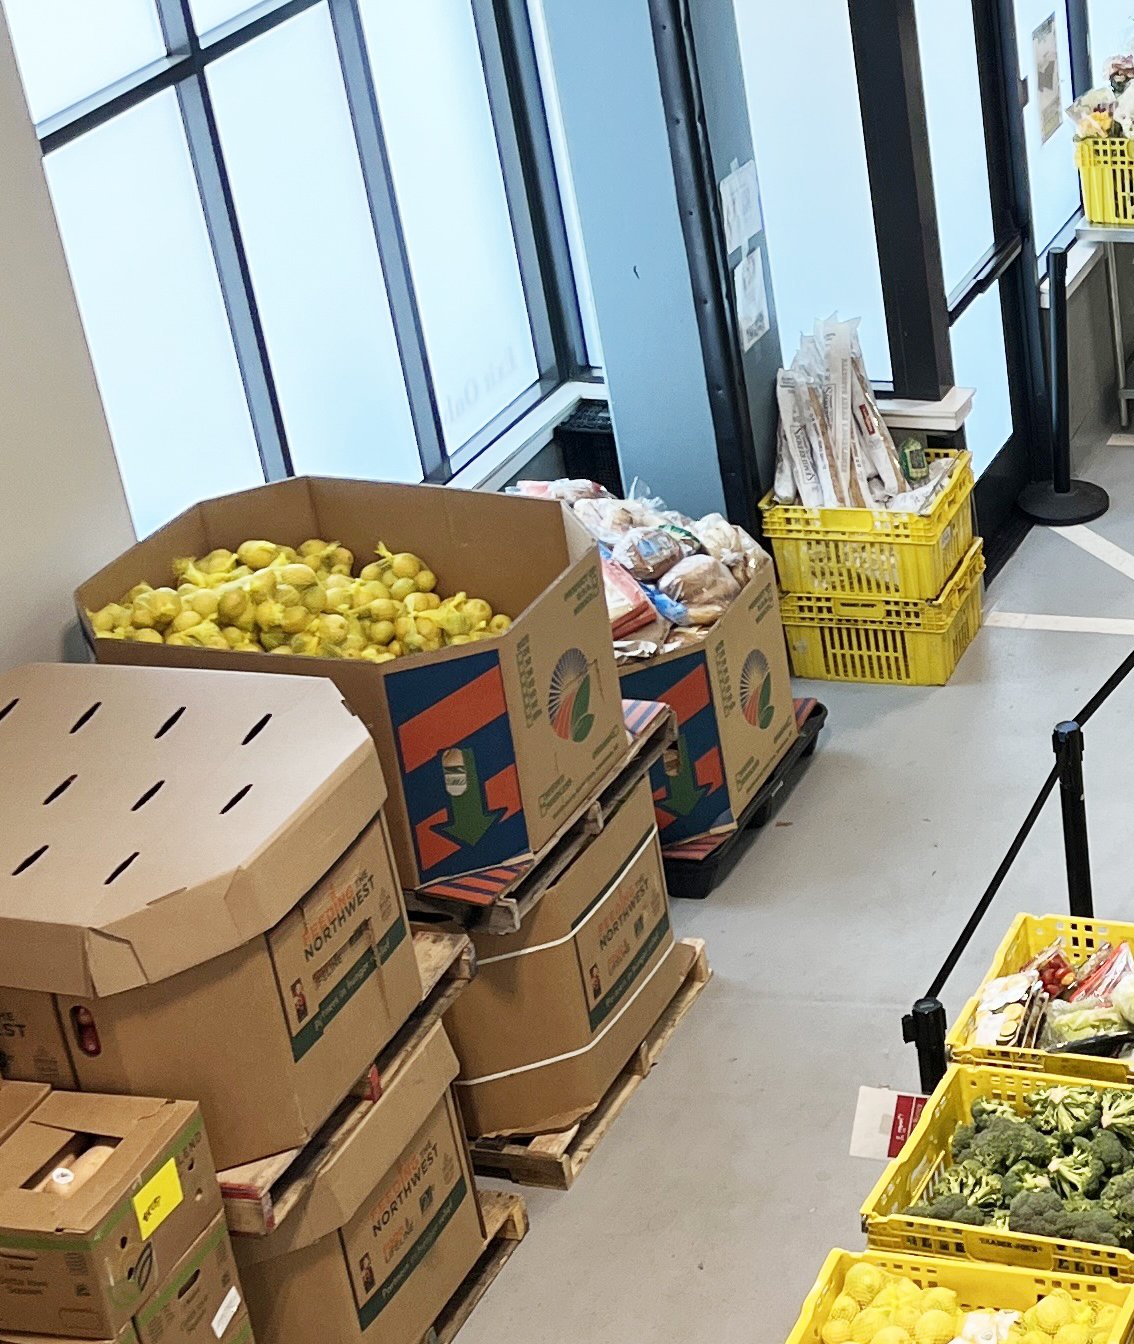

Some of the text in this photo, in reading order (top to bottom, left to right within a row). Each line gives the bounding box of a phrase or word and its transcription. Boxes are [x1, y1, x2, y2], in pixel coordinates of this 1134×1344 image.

[304, 874, 375, 962] NORTHWEST
[599, 880, 651, 952] NORTHWEST
[372, 1142, 440, 1238] NORTHWEST
